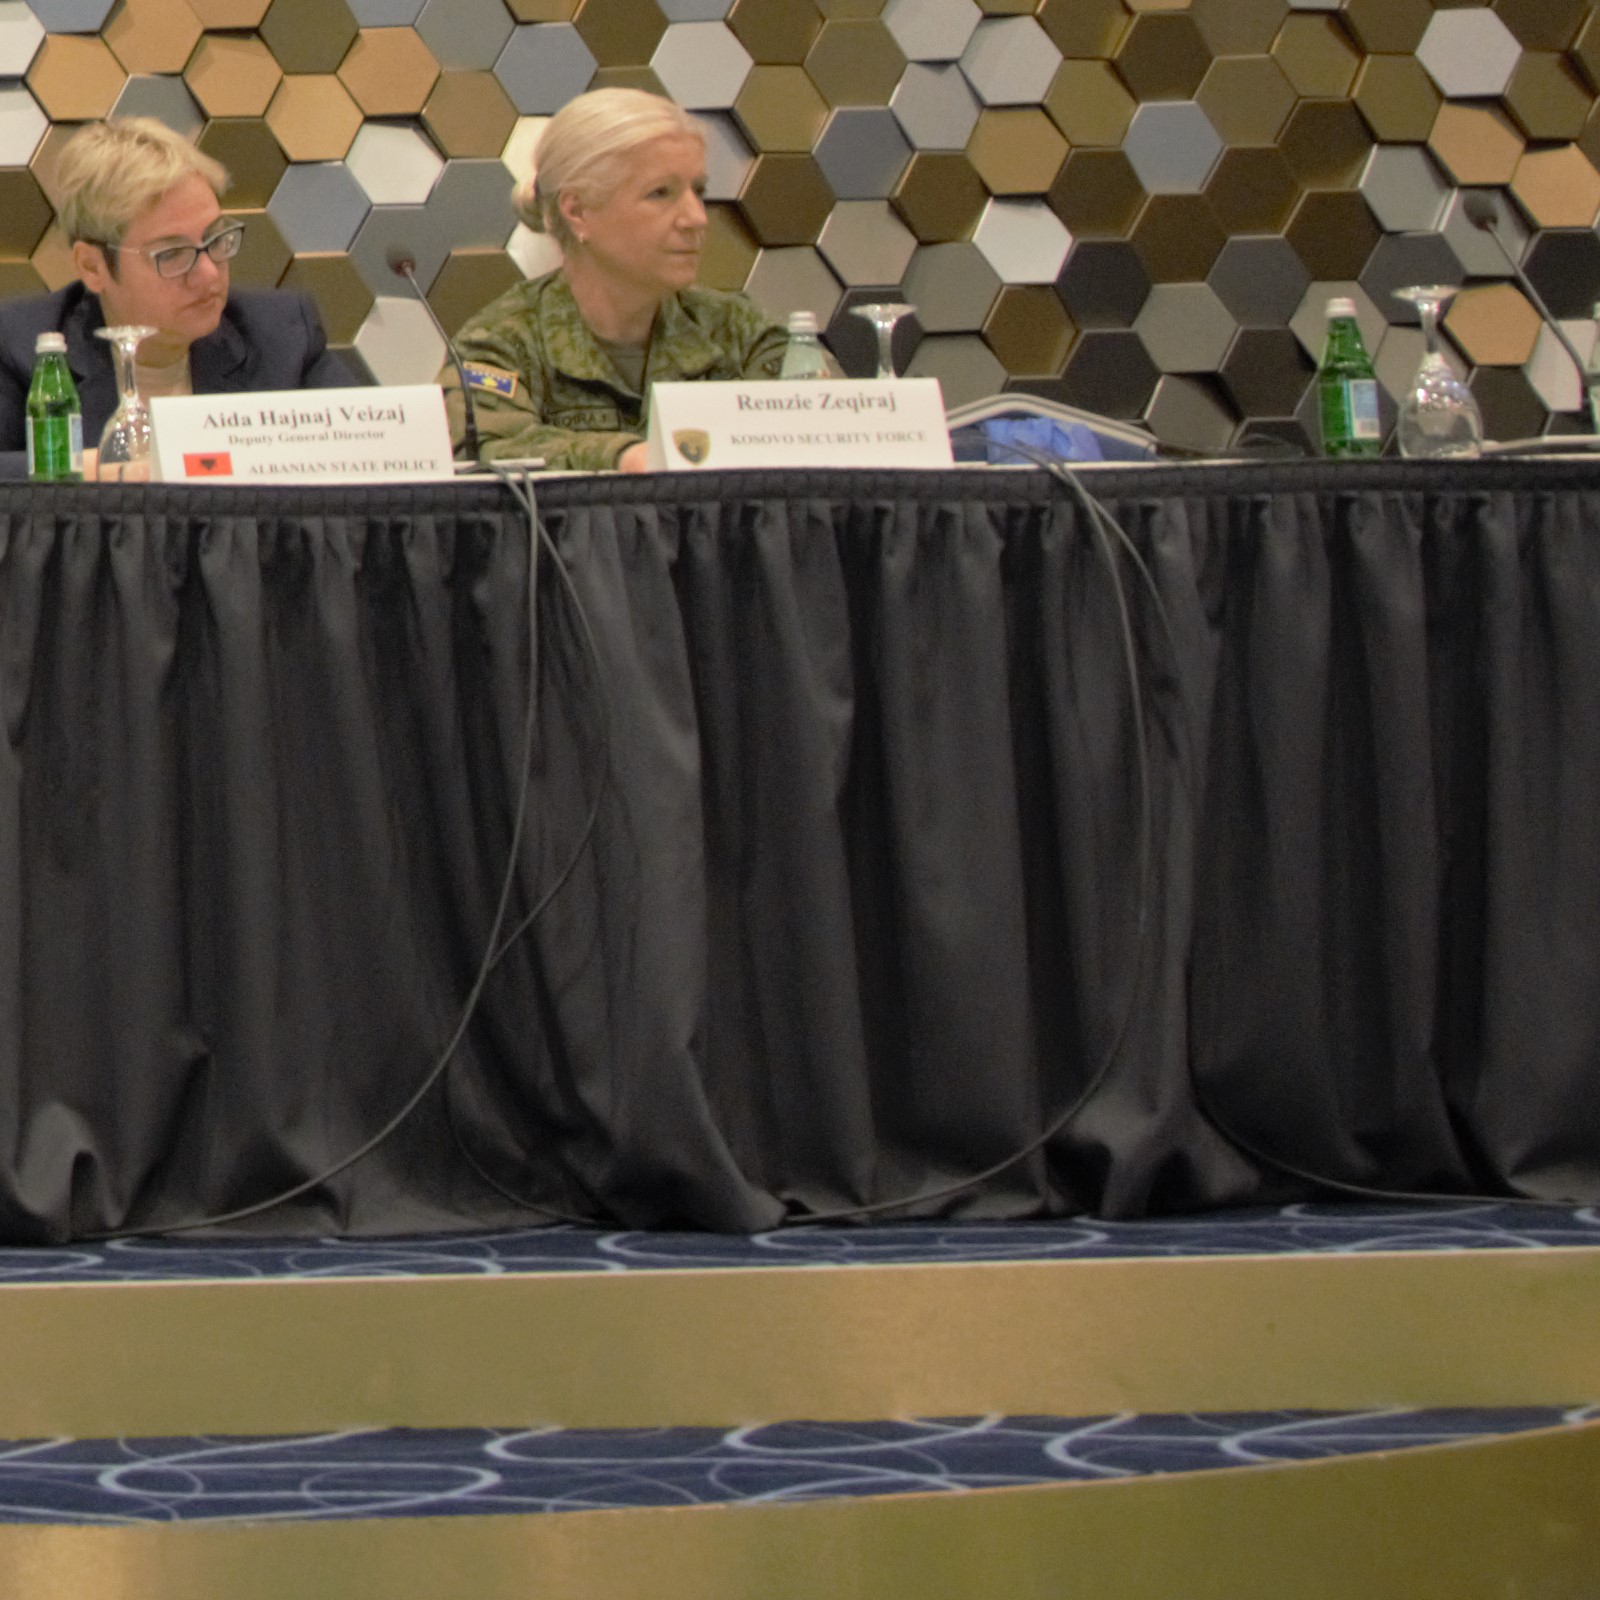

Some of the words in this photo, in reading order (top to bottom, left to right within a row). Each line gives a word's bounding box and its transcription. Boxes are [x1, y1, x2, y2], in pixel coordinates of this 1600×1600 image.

[737, 394, 812, 411] Remzie
[818, 391, 897, 413] Zeqiraj
[203, 410, 251, 429] Aida
[260, 408, 332, 428] Hajnaj
[339, 403, 406, 424] Veizaj
[228, 433, 274, 446] Deputy
[278, 431, 329, 443] General
[333, 429, 386, 441] Director
[730, 433, 794, 445] KOSOVO
[797, 431, 871, 445] SECURITY
[875, 430, 927, 443] FORCE
[249, 462, 328, 475] ALBANIAN
[331, 461, 379, 474] STATE
[383, 459, 439, 472] POLICE
